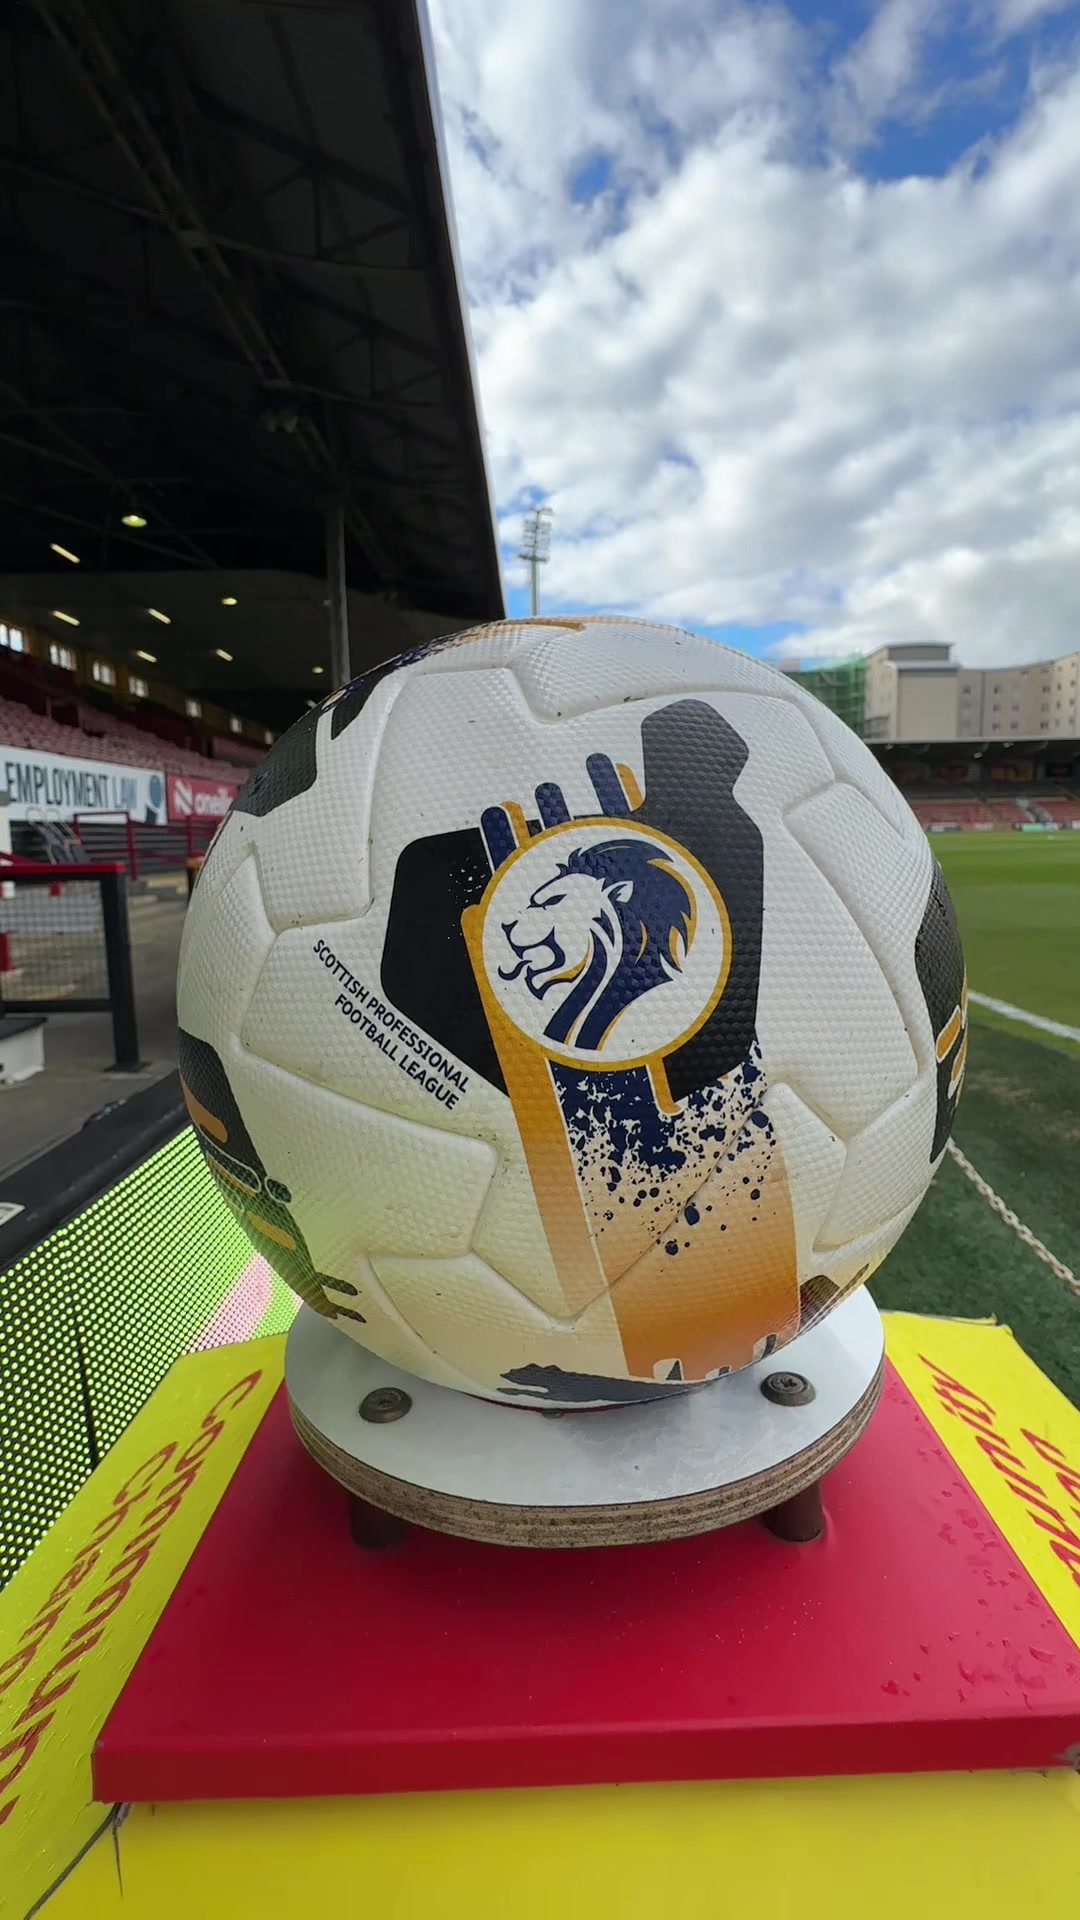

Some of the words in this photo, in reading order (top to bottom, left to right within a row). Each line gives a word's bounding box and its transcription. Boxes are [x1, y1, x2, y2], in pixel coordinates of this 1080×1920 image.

[5, 761, 109, 808] EMPLOYMENT
[111, 775, 138, 809] LAW
[313, 939, 370, 1003] SCOTTISH
[366, 996, 471, 1094] PROFESSIONAL
[334, 993, 399, 1062] FOOTBALL
[398, 1054, 460, 1110] LEAGUE
[0, 1368, 263, 1825] Commun
